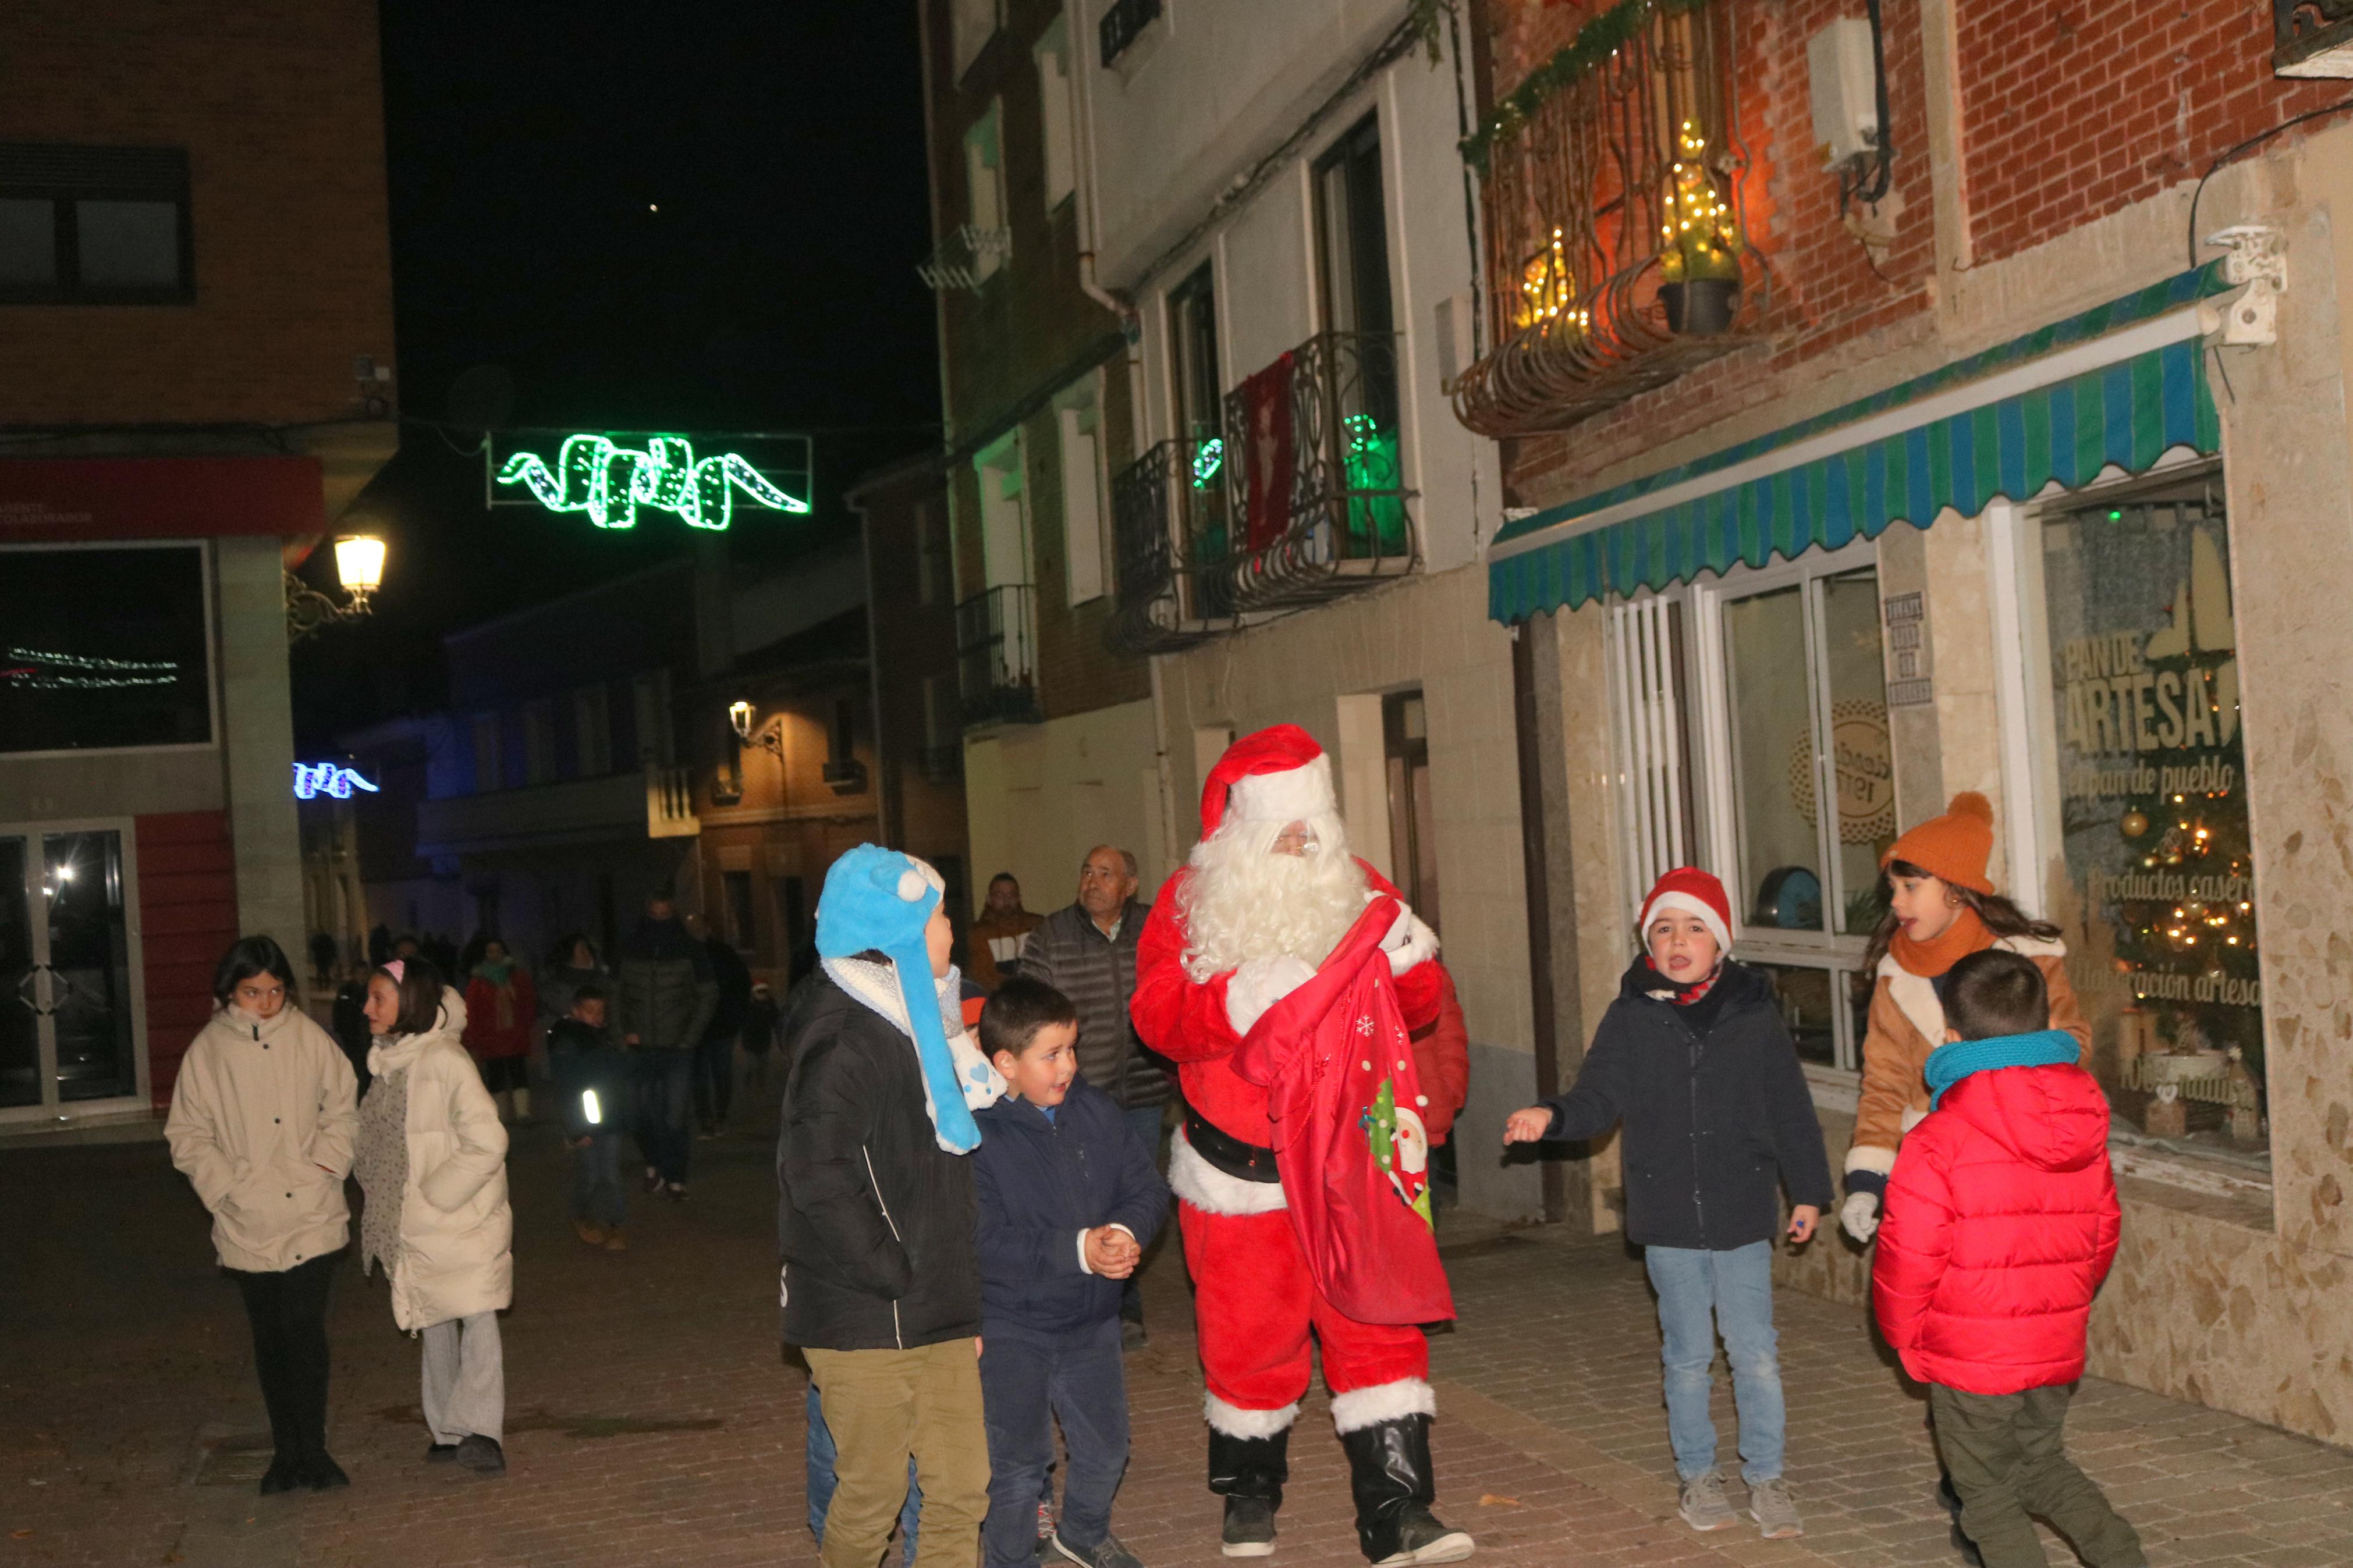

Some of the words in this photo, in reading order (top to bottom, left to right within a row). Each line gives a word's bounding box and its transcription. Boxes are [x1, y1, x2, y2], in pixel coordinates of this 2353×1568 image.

[2065, 637, 2110, 681] PAN
[2112, 630, 2142, 675] DE
[2130, 758, 2155, 794] de
[2159, 755, 2235, 805] pueblo
[2088, 865, 2185, 901] Productos
